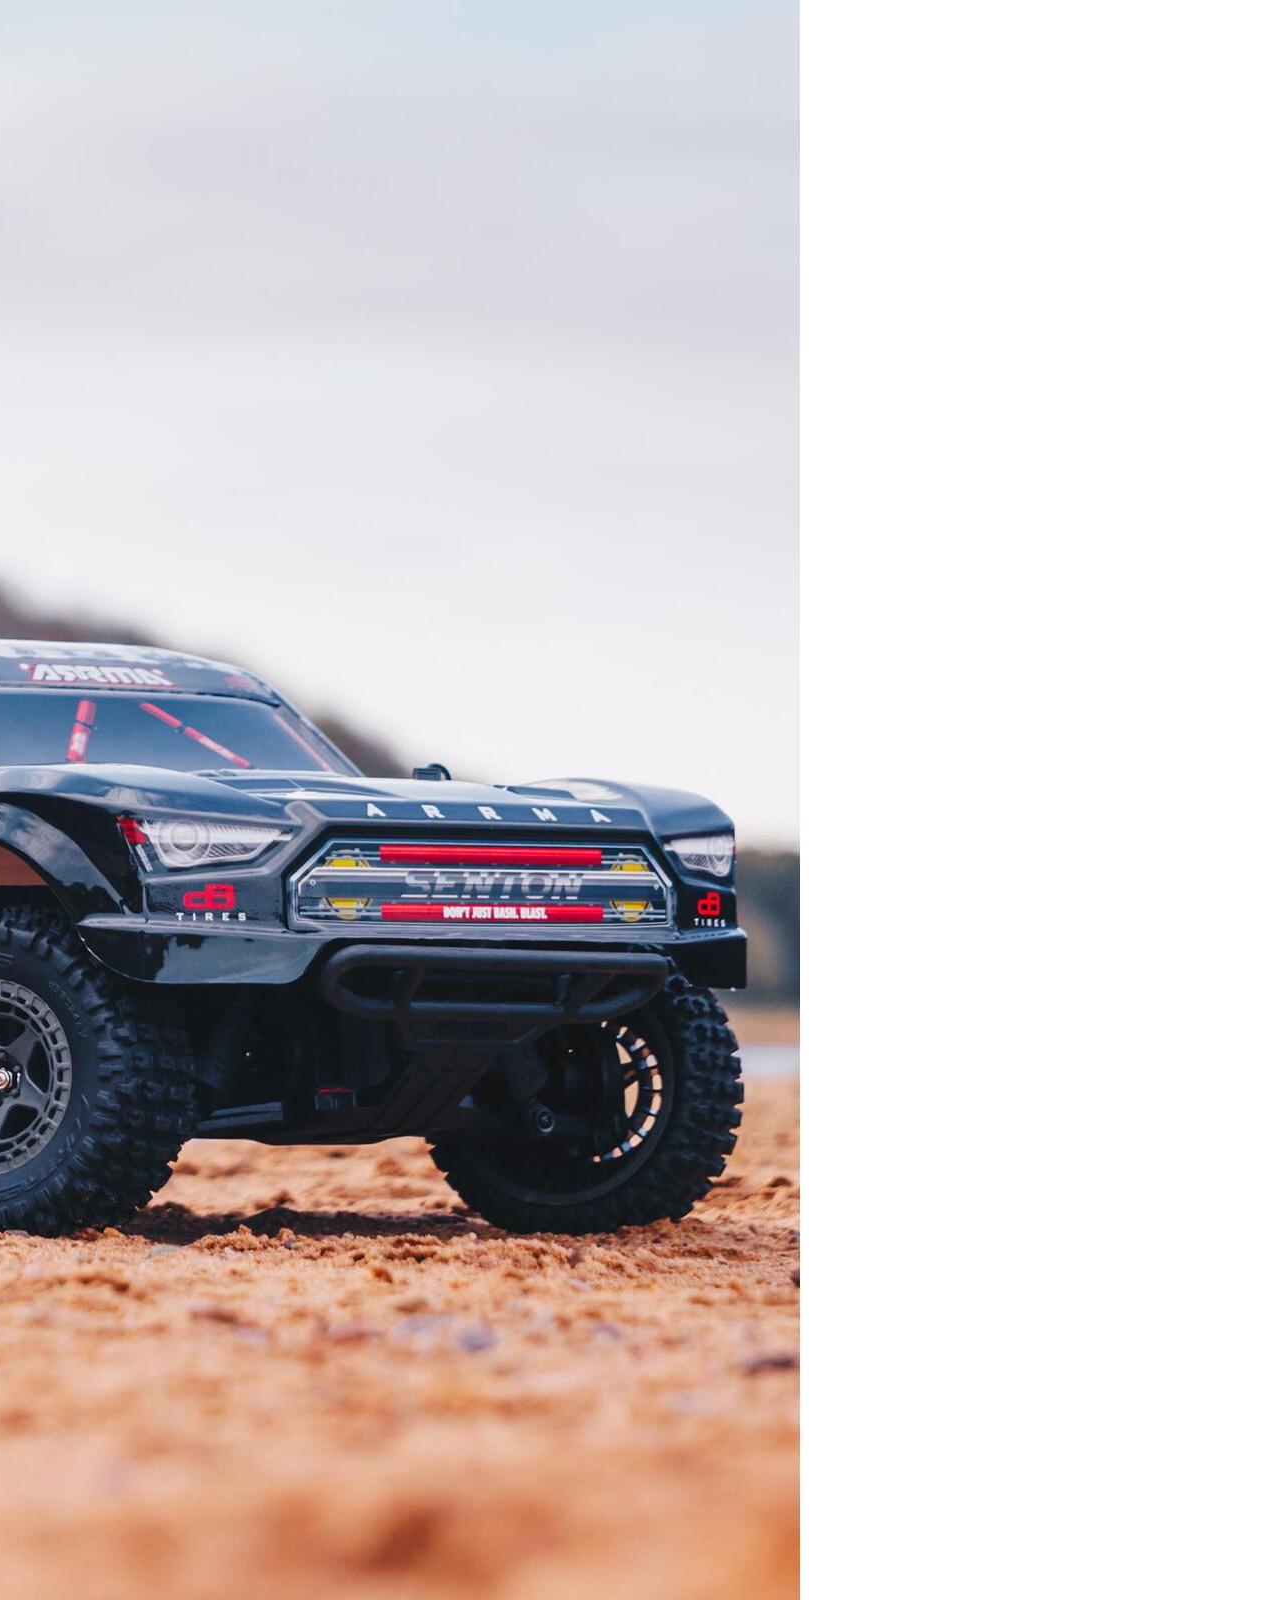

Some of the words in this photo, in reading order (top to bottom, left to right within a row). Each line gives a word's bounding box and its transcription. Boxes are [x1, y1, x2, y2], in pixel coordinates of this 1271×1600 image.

[366, 803, 611, 823] ARRMA
[401, 871, 585, 900] SENTON
[175, 912, 247, 921] TIRES
[472, 907, 492, 919] JUST
[521, 908, 548, 920] BLAST.
[694, 918, 726, 928] TIRES
